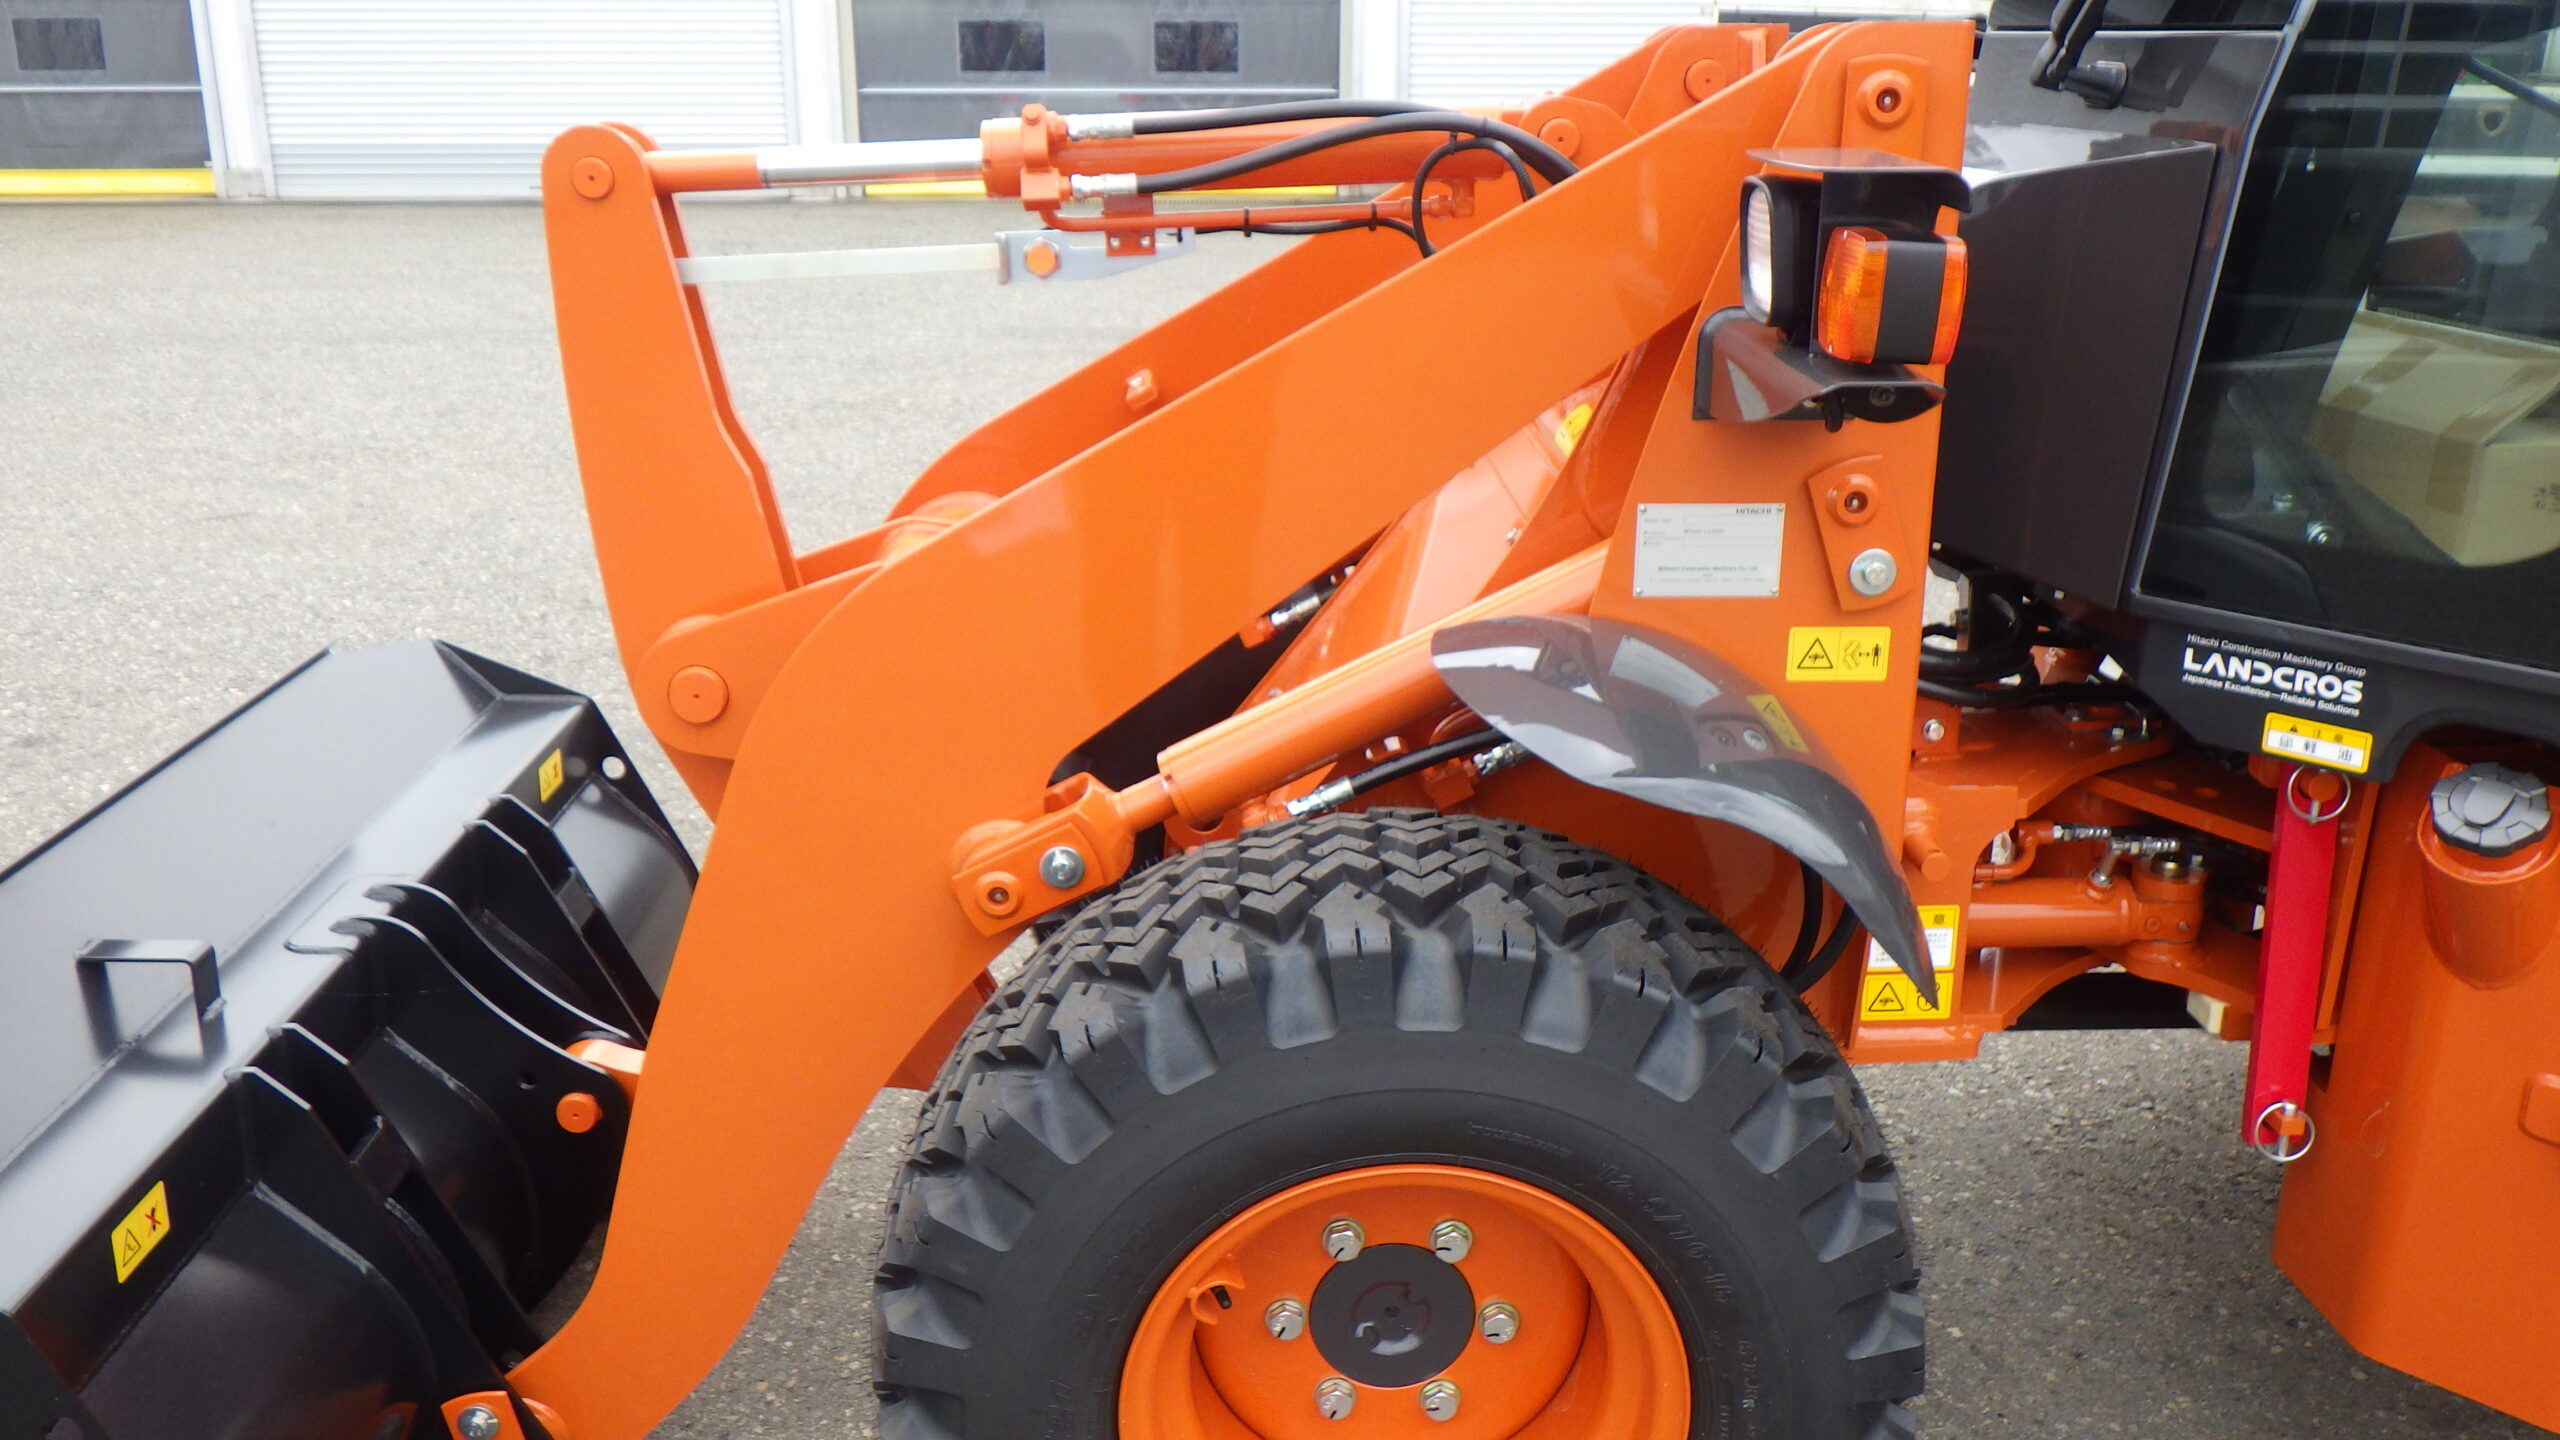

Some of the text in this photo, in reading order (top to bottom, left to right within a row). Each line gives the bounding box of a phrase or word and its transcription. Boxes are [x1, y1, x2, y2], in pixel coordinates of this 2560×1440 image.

[2183, 647, 2364, 704] LANDCROS
[2187, 633, 2367, 678] Hitachi Construction Machinery Group
[2182, 672, 2223, 689] Japanese
[2318, 699, 2360, 718] Solutions
